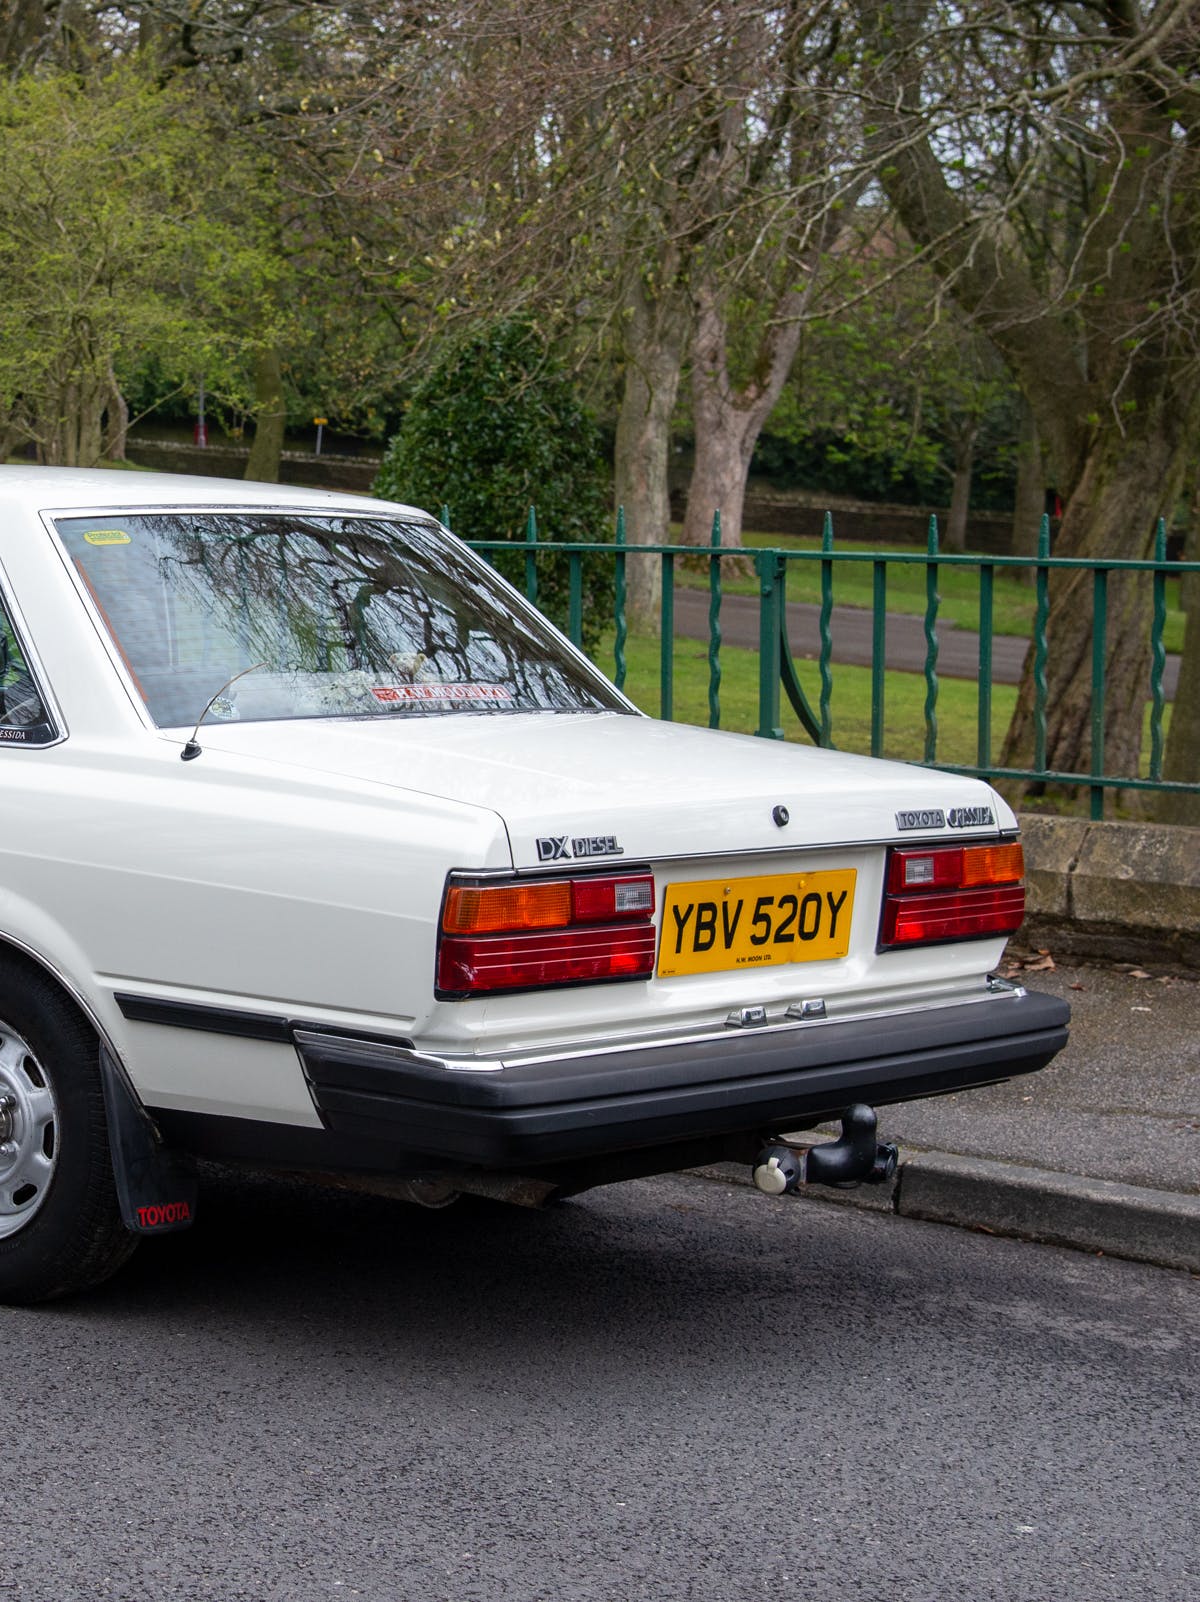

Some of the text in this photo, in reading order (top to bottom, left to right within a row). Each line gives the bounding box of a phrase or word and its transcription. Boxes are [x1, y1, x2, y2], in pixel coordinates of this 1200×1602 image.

[898, 810, 945, 828] TOYOTA
[536, 836, 624, 860] DX DIESEL
[673, 890, 848, 954] YBV 520Y
[137, 1202, 190, 1227] TOYOTA
